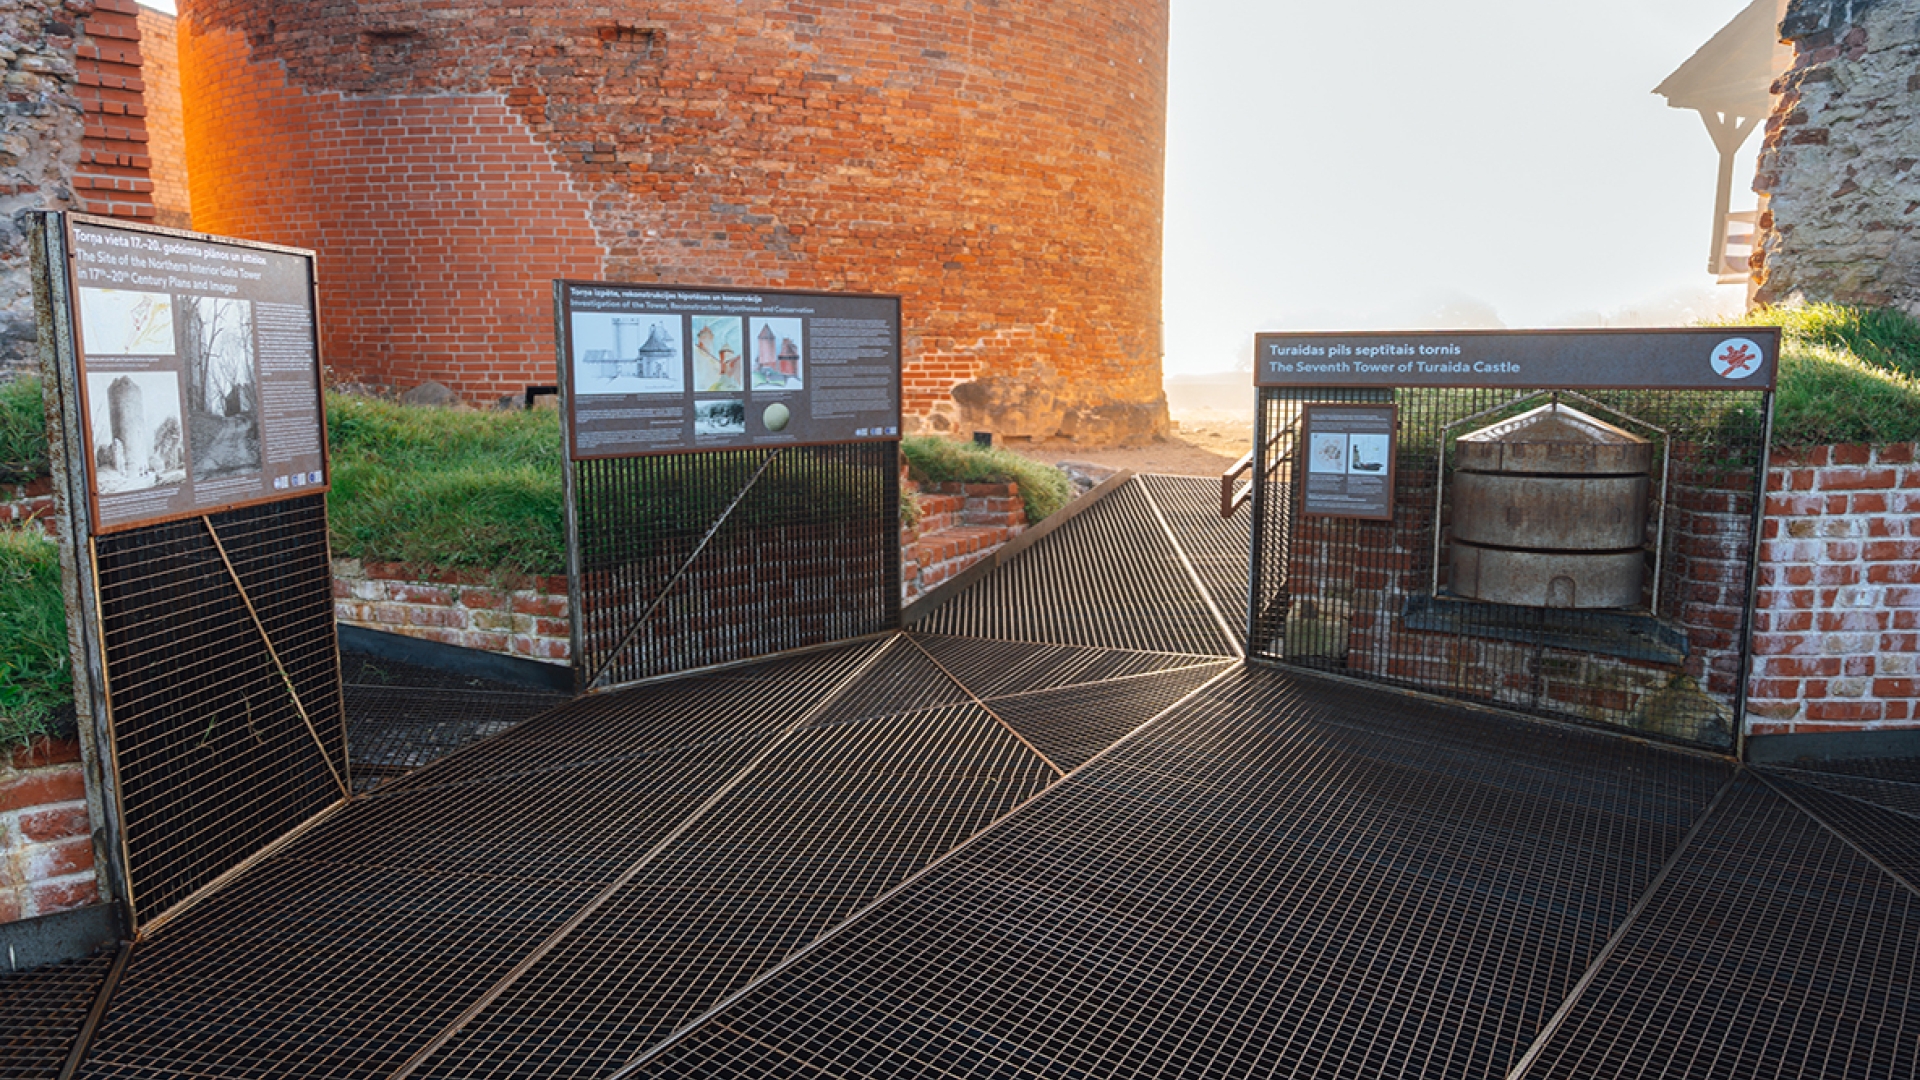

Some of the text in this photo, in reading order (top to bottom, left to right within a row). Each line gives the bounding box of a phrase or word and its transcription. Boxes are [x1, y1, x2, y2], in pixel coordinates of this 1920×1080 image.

[104, 233, 129, 248] vieta
[230, 252, 240, 262] un
[75, 247, 262, 281] The Site of the Northern Interior Gate Tower
[131, 271, 167, 290] Century
[168, 275, 192, 289] Plans
[193, 279, 208, 291] and
[209, 281, 238, 295] Images
[570, 299, 620, 310] Investigation
[621, 300, 631, 309] of
[631, 301, 645, 309] the
[671, 303, 721, 311] Reconstruction
[762, 305, 775, 313] and
[775, 305, 815, 313] Conservation
[1269, 343, 1325, 356] Turaidas
[1328, 343, 1352, 358] pils
[1418, 343, 1462, 356] tornis
[1269, 360, 1521, 373] The Seventh Tower of Turaida Castle
